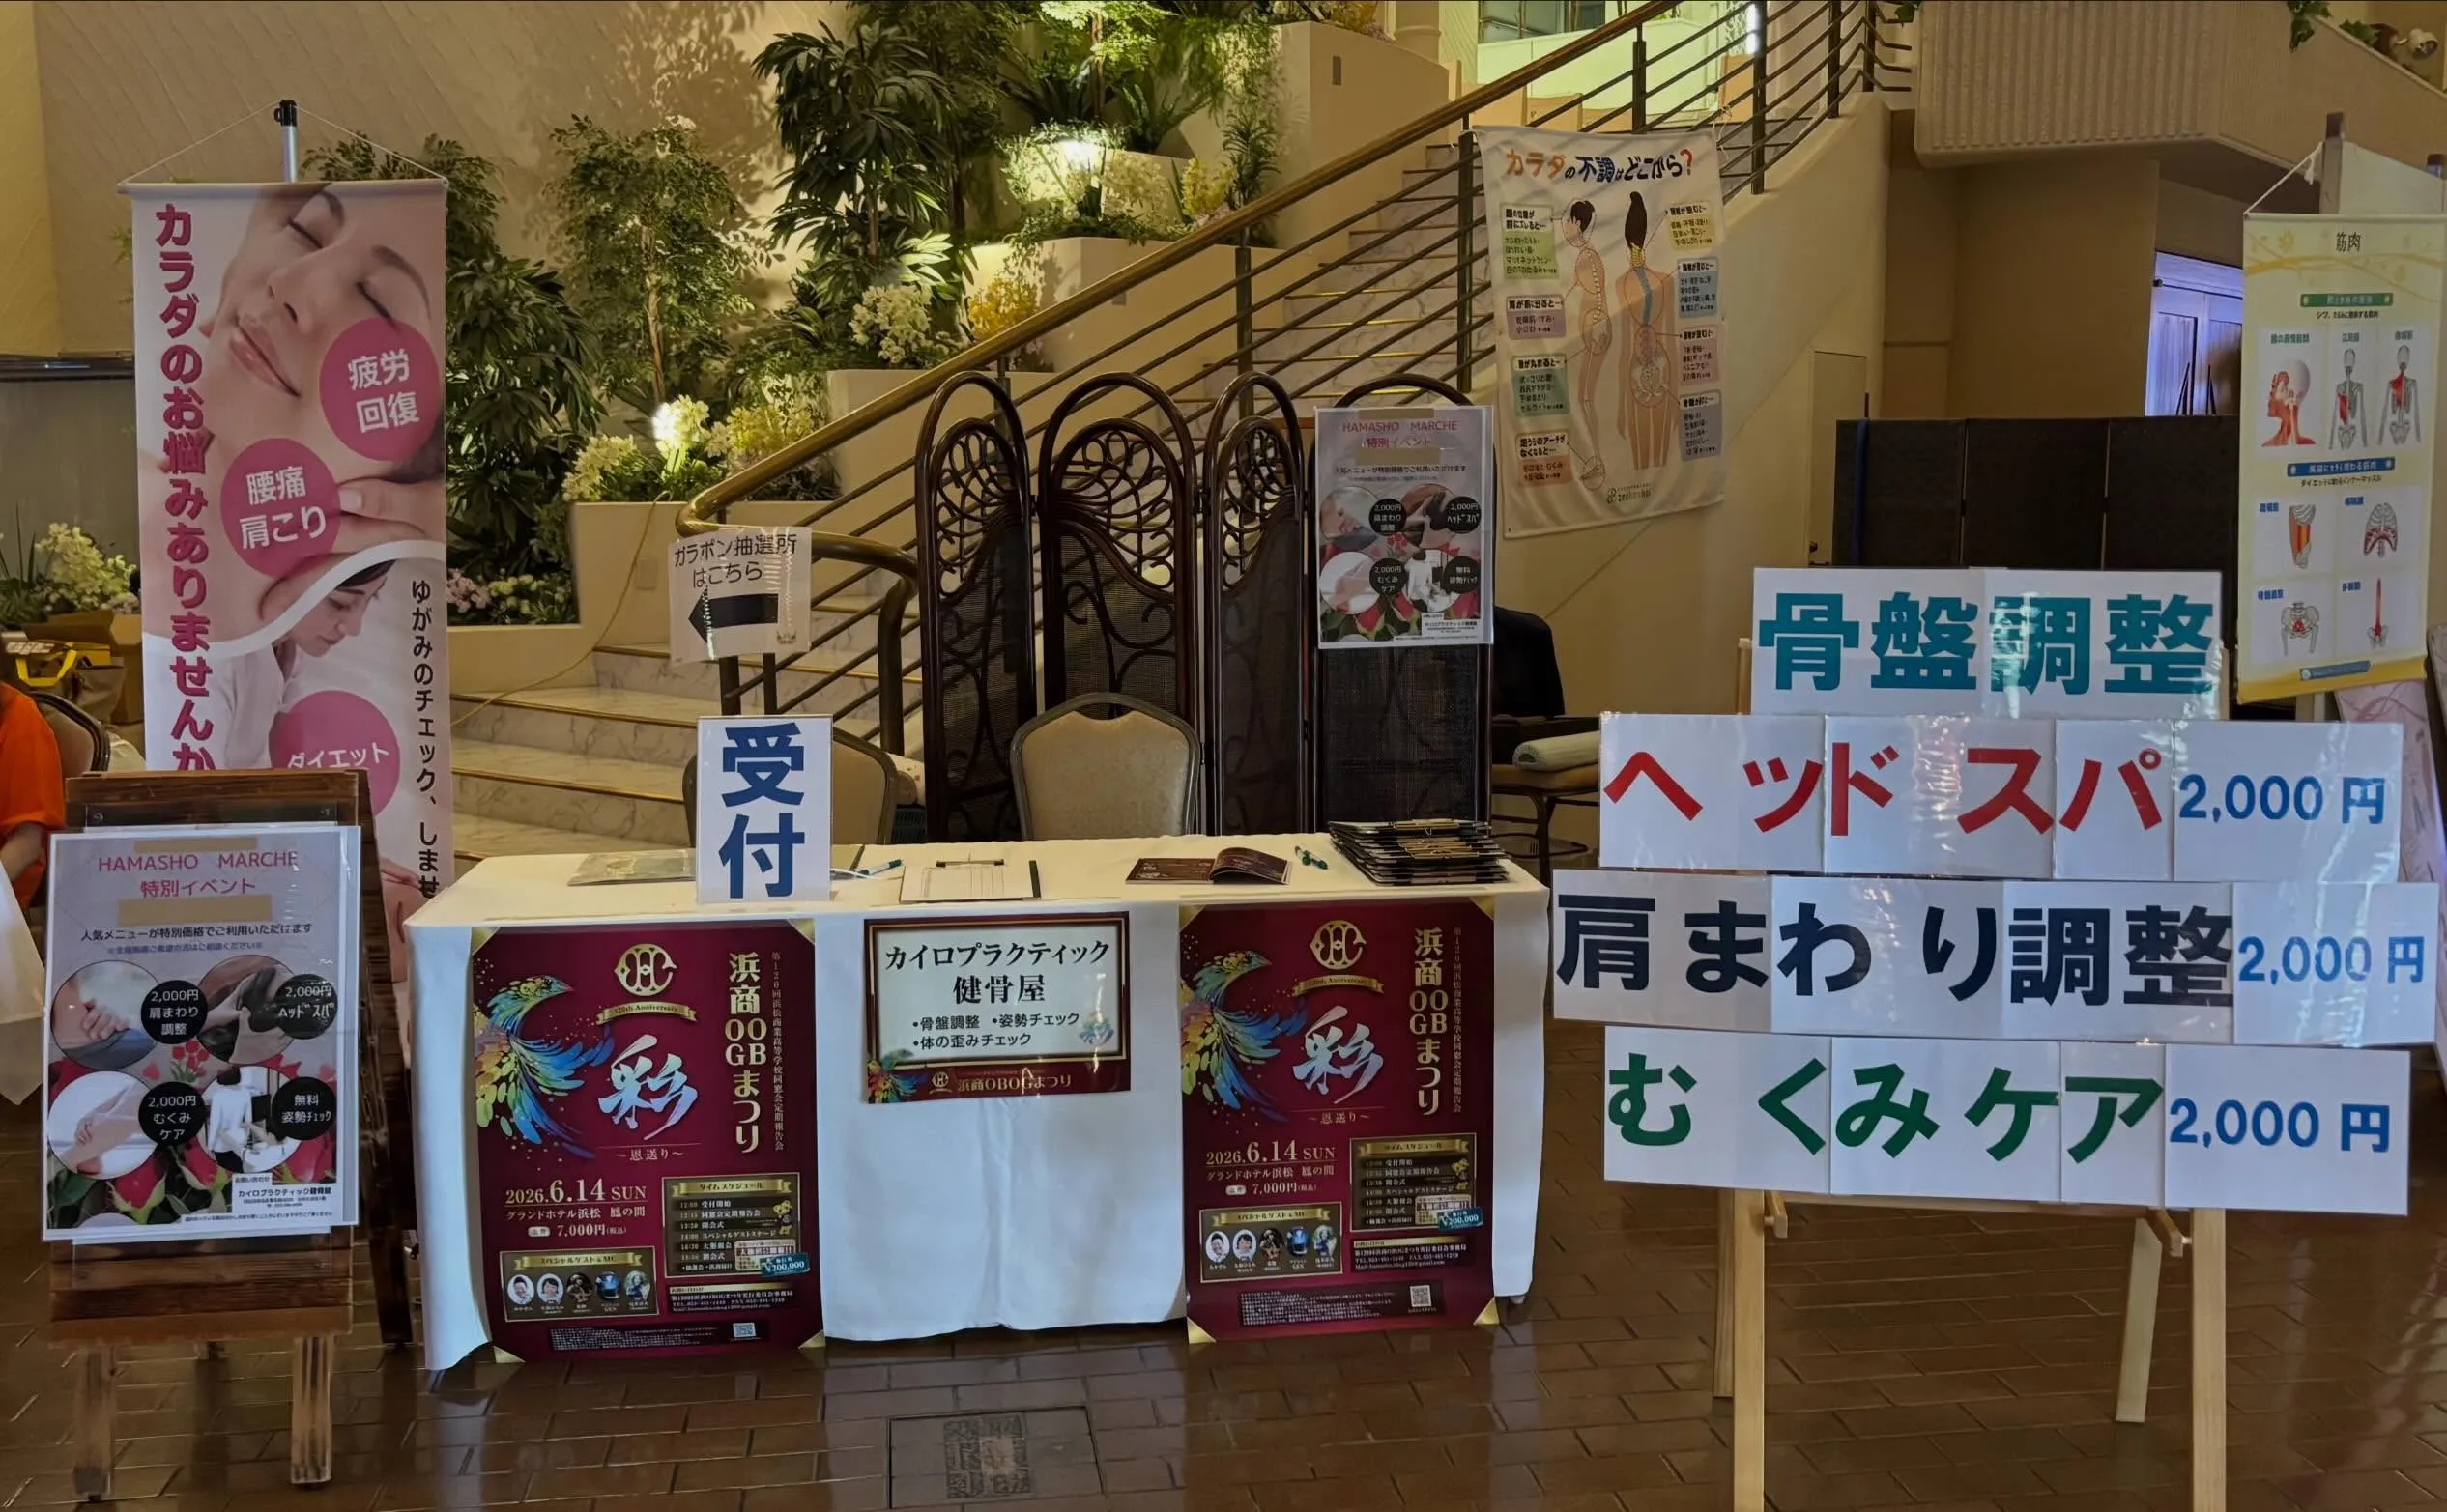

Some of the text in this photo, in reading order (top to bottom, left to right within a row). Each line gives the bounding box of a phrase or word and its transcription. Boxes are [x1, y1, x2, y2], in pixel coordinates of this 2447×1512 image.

[2336, 232, 2361, 253] 筋肉
[348, 349, 411, 390] 疲労
[355, 390, 419, 434] 回復
[1342, 420, 1458, 433] HAMASHO MARCHE
[1367, 437, 1432, 448] 特別イベント
[155, 203, 216, 770] カラダのお悩みありませんか
[246, 466, 306, 506] 腰痛
[240, 505, 327, 551] 肩こり
[693, 561, 763, 587] はこちら
[1758, 591, 2214, 698] 骨盤調整
[287, 742, 389, 769] ダイエット
[719, 722, 805, 899] 受付
[99, 851, 299, 871] HAMASHO MARCHE
[140, 878, 256, 899] 特別イベント
[81, 924, 312, 942] 人気メニューが特別価格でご利用いただけます
[885, 940, 1109, 970] カイロプラクティック
[151, 989, 199, 1002] 2,000円
[285, 985, 332, 998] 2,000円
[953, 974, 1046, 1005] 健骨屋
[149, 1008, 199, 1019] 肩まわり
[161, 1024, 187, 1036] 調整
[1292, 1005, 1383, 1104] 彩
[598, 1034, 697, 1140] 彩
[148, 1095, 196, 1108] 2,000円
[294, 1094, 319, 1106] 無料
[153, 1111, 191, 1125] むくみ
[159, 1128, 186, 1141] ケア
[1206, 1139, 1336, 1165] 2026.6.14 SUN
[1207, 1166, 1293, 1180] グランドホテル浜松
[505, 1178, 647, 1205] 2026.6.14 SUN
[506, 1208, 602, 1220] グランドホテル浜松
